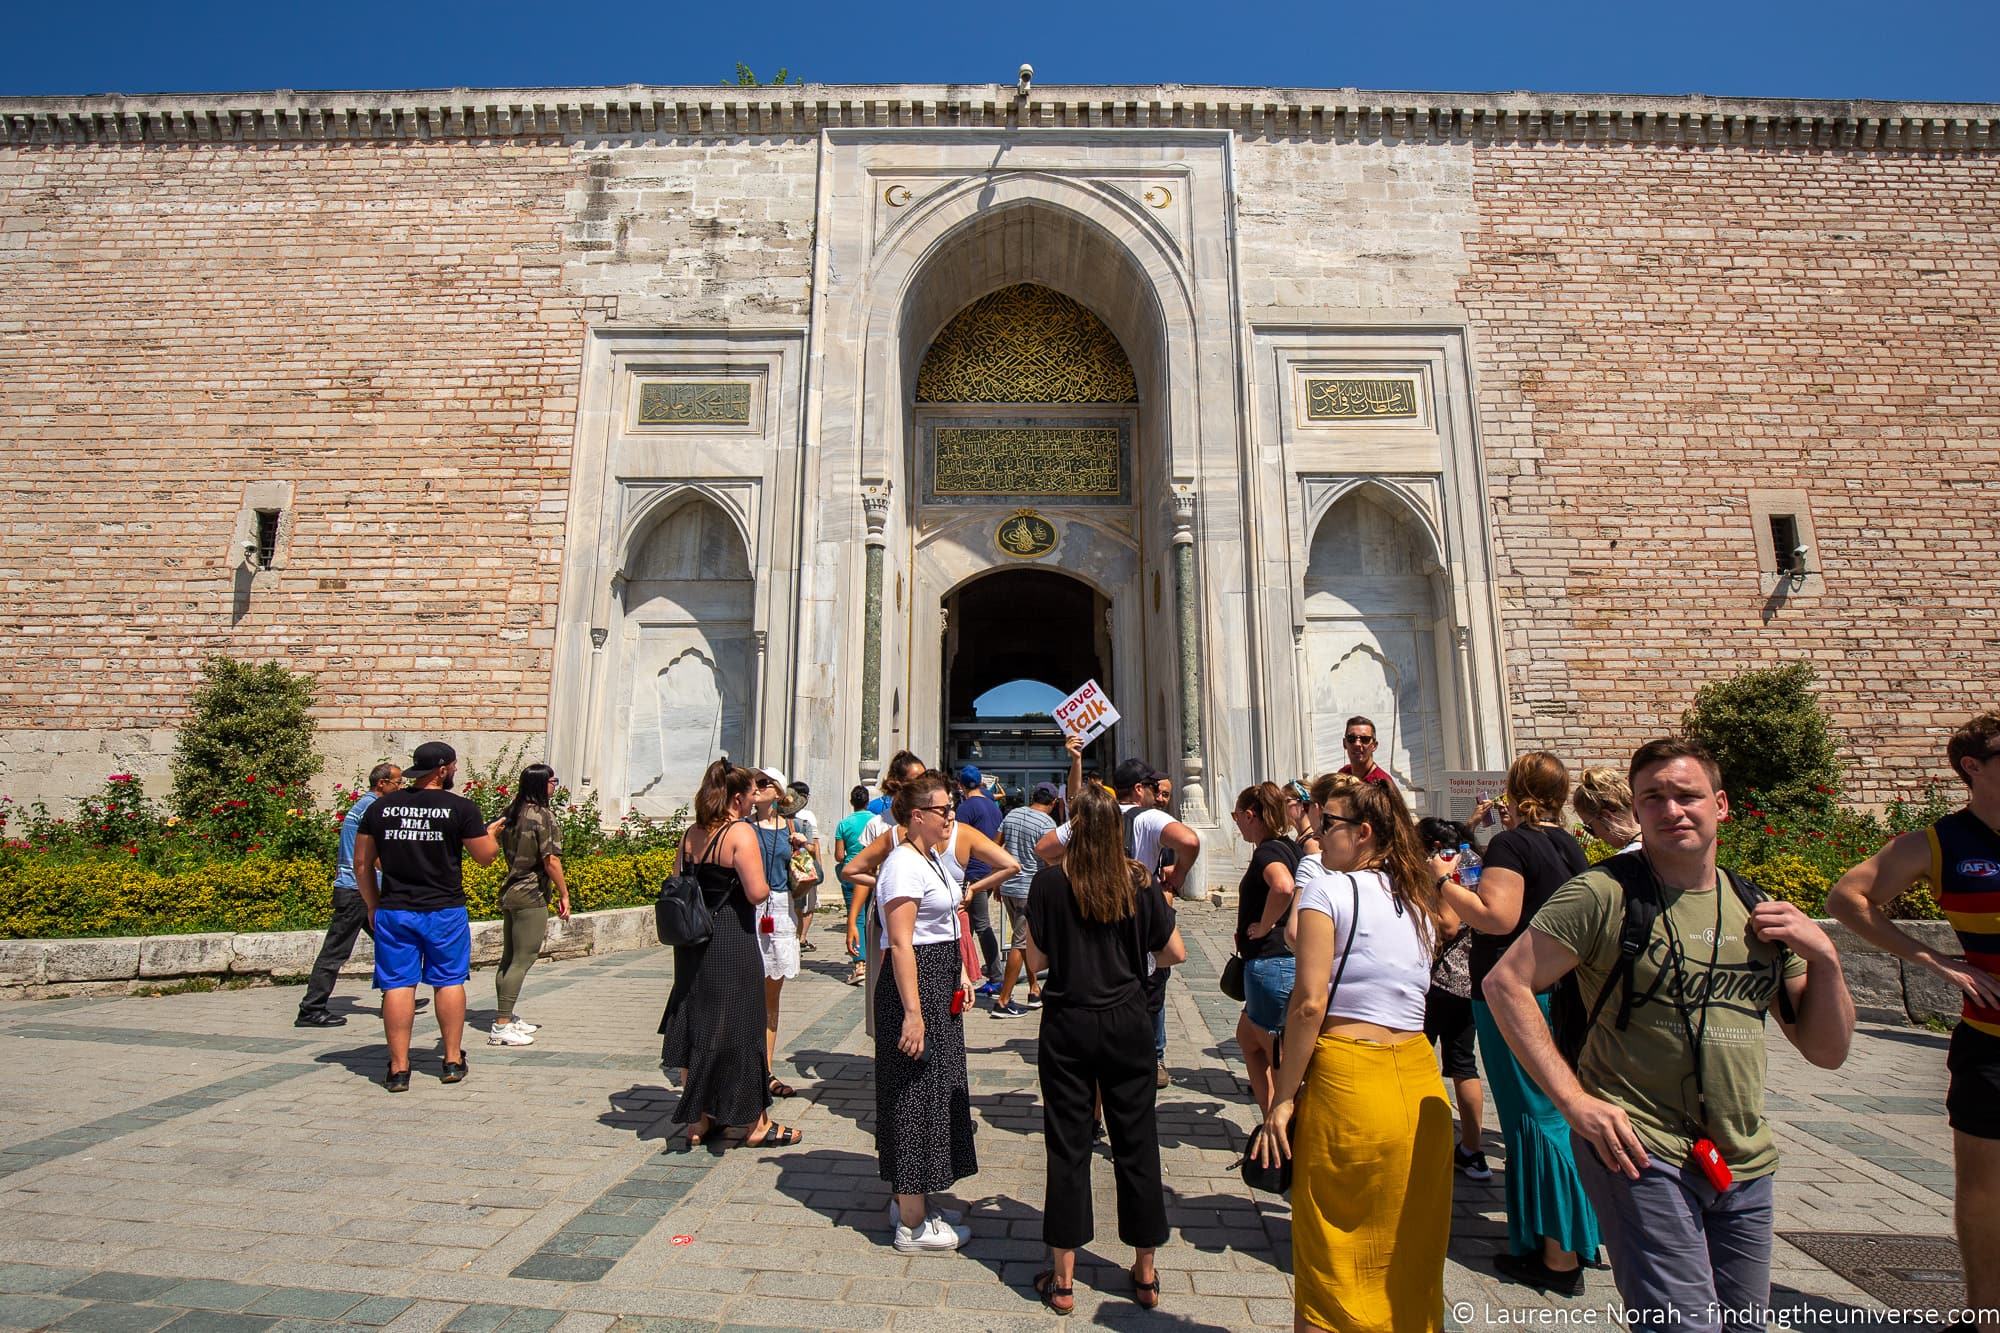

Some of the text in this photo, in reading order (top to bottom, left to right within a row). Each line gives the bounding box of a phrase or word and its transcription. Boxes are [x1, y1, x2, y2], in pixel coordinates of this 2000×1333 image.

[1056, 682, 1097, 720] travel
[1065, 699, 1108, 734] talk
[382, 806, 452, 819] SCORPION
[400, 818, 431, 830] MMA
[384, 829, 444, 841] FIGHTER
[1962, 862, 1992, 873] AFL
[1632, 938, 1778, 1014] Legend
